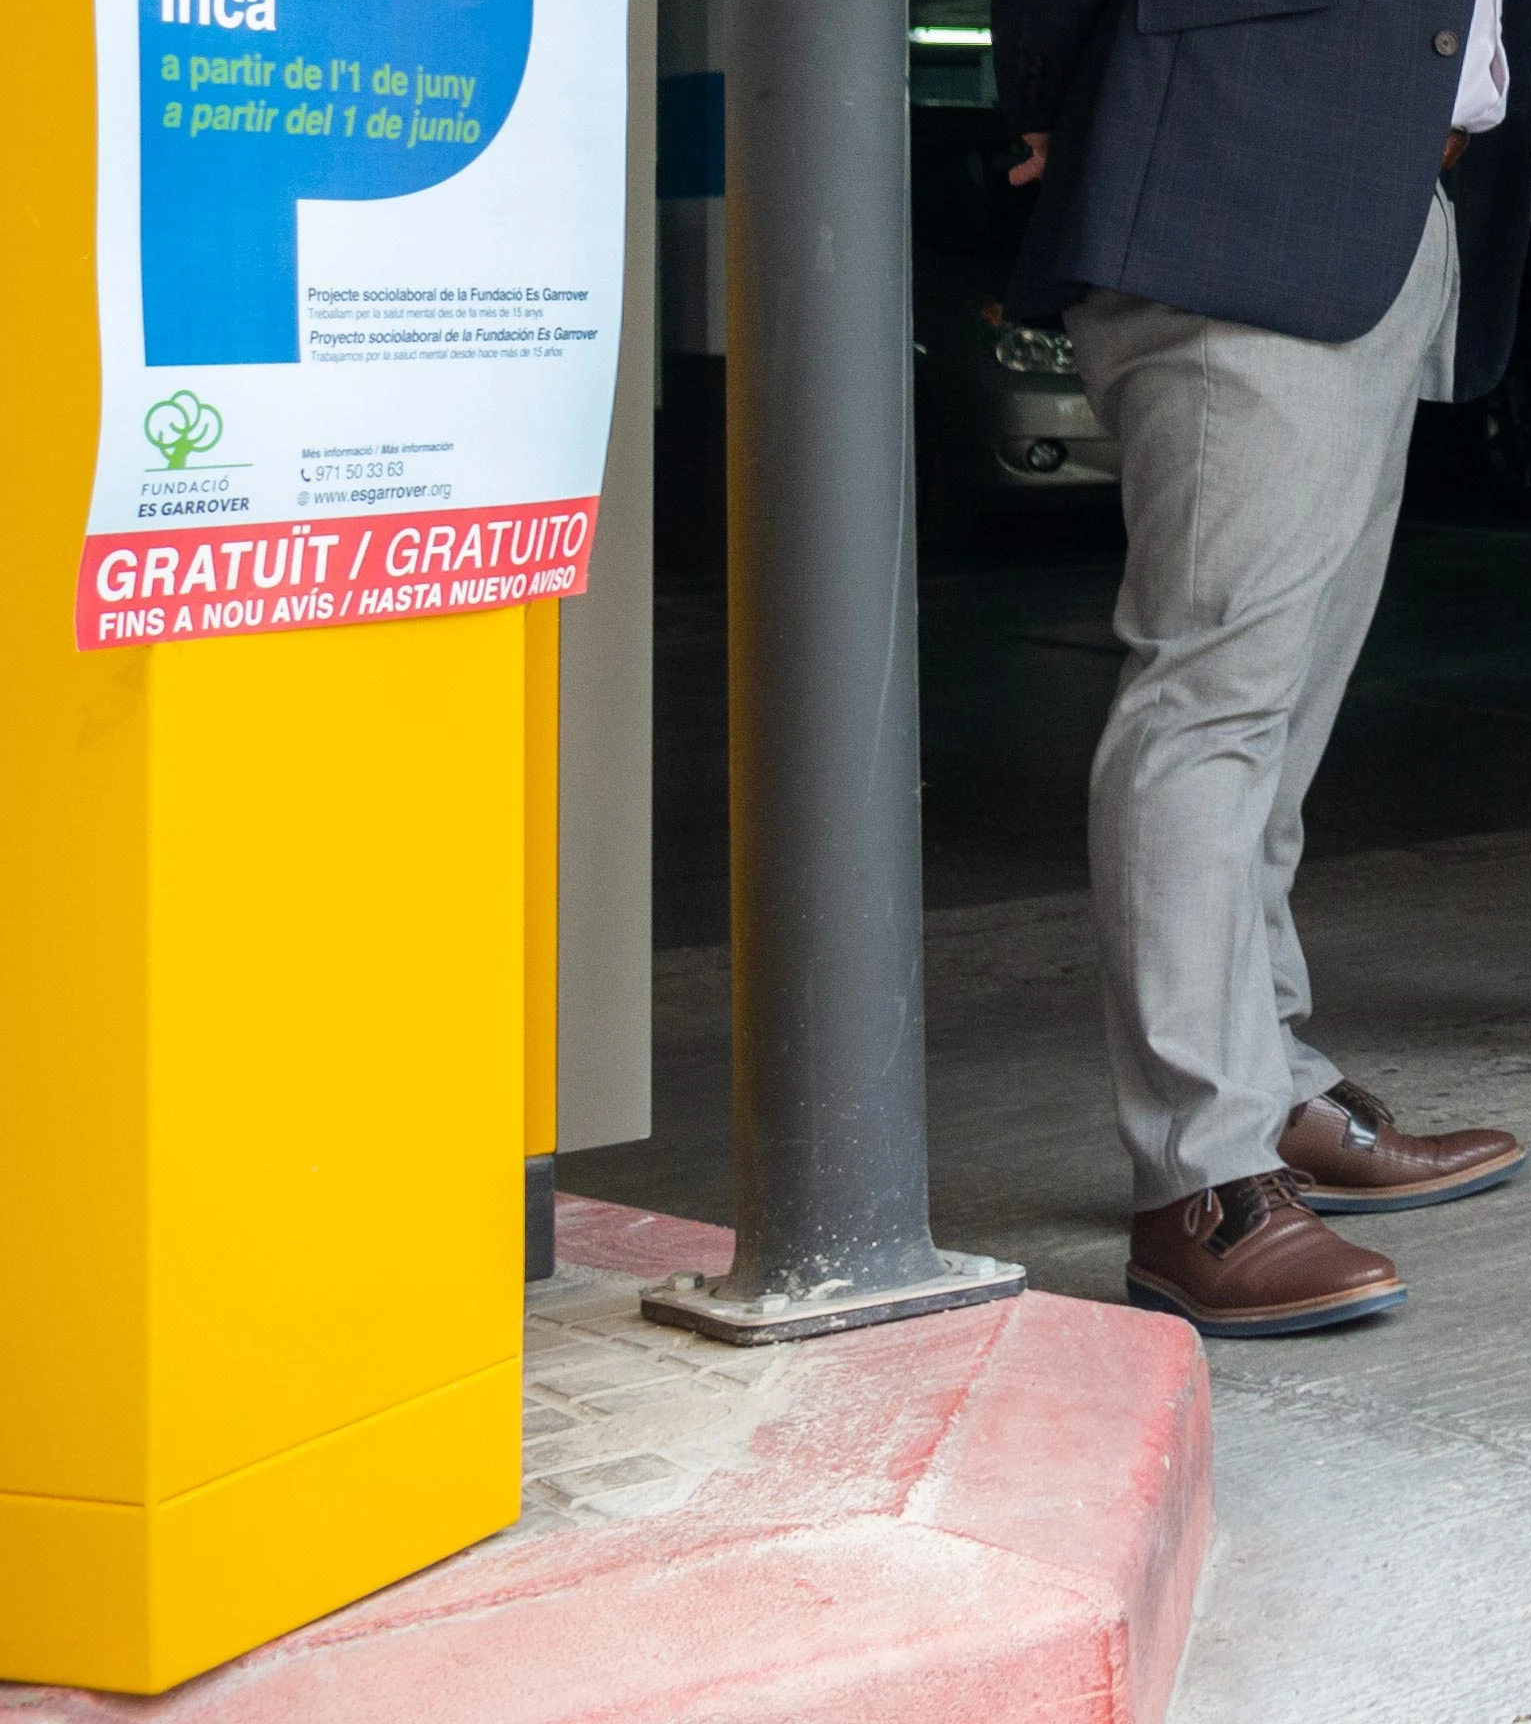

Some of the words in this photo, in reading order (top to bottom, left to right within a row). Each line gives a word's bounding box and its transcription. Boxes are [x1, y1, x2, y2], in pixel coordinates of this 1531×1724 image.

[161, 54, 180, 81] a
[190, 53, 276, 92] partir
[284, 56, 322, 90] de
[331, 59, 361, 93] l'1
[372, 63, 408, 96] de
[414, 65, 476, 108] juny
[163, 101, 182, 128] a
[190, 99, 279, 137] partir
[285, 103, 333, 136] del
[343, 106, 357, 137] 1
[366, 107, 401, 140] de
[407, 109, 482, 148] junio
[308, 287, 359, 305] Projecte
[363, 287, 437, 302] sociolaboral
[439, 287, 454, 301] de
[457, 287, 467, 301] la
[470, 287, 523, 301] Fundació
[526, 288, 540, 301] Es
[542, 287, 589, 301] Garrover
[310, 330, 365, 347] Proyecto
[369, 328, 441, 343] sociolaboral
[445, 329, 459, 342] de
[462, 329, 472, 341] la
[475, 327, 534, 341] Fundación
[537, 327, 551, 341] Es
[554, 327, 598, 340] Garrover
[315, 465, 340, 482] 971
[345, 464, 363, 480] 50
[366, 462, 384, 478] 33
[387, 460, 404, 477] 63
[141, 475, 230, 496] FUNDACIÓ
[314, 483, 452, 505] www.esgarrover.org
[137, 502, 157, 518] ES
[160, 496, 250, 517] GARROVER
[95, 524, 340, 602] GRATUÏT
[349, 530, 372, 580] /
[385, 511, 589, 577] GRATUITO
[99, 606, 166, 641] FINS
[172, 605, 193, 634] A
[201, 598, 264, 631] NOU
[271, 586, 335, 624] AVÍS
[339, 589, 354, 617] /
[358, 584, 443, 617] HASTA
[448, 573, 527, 606] NUEVO
[528, 564, 577, 596] AVISO
